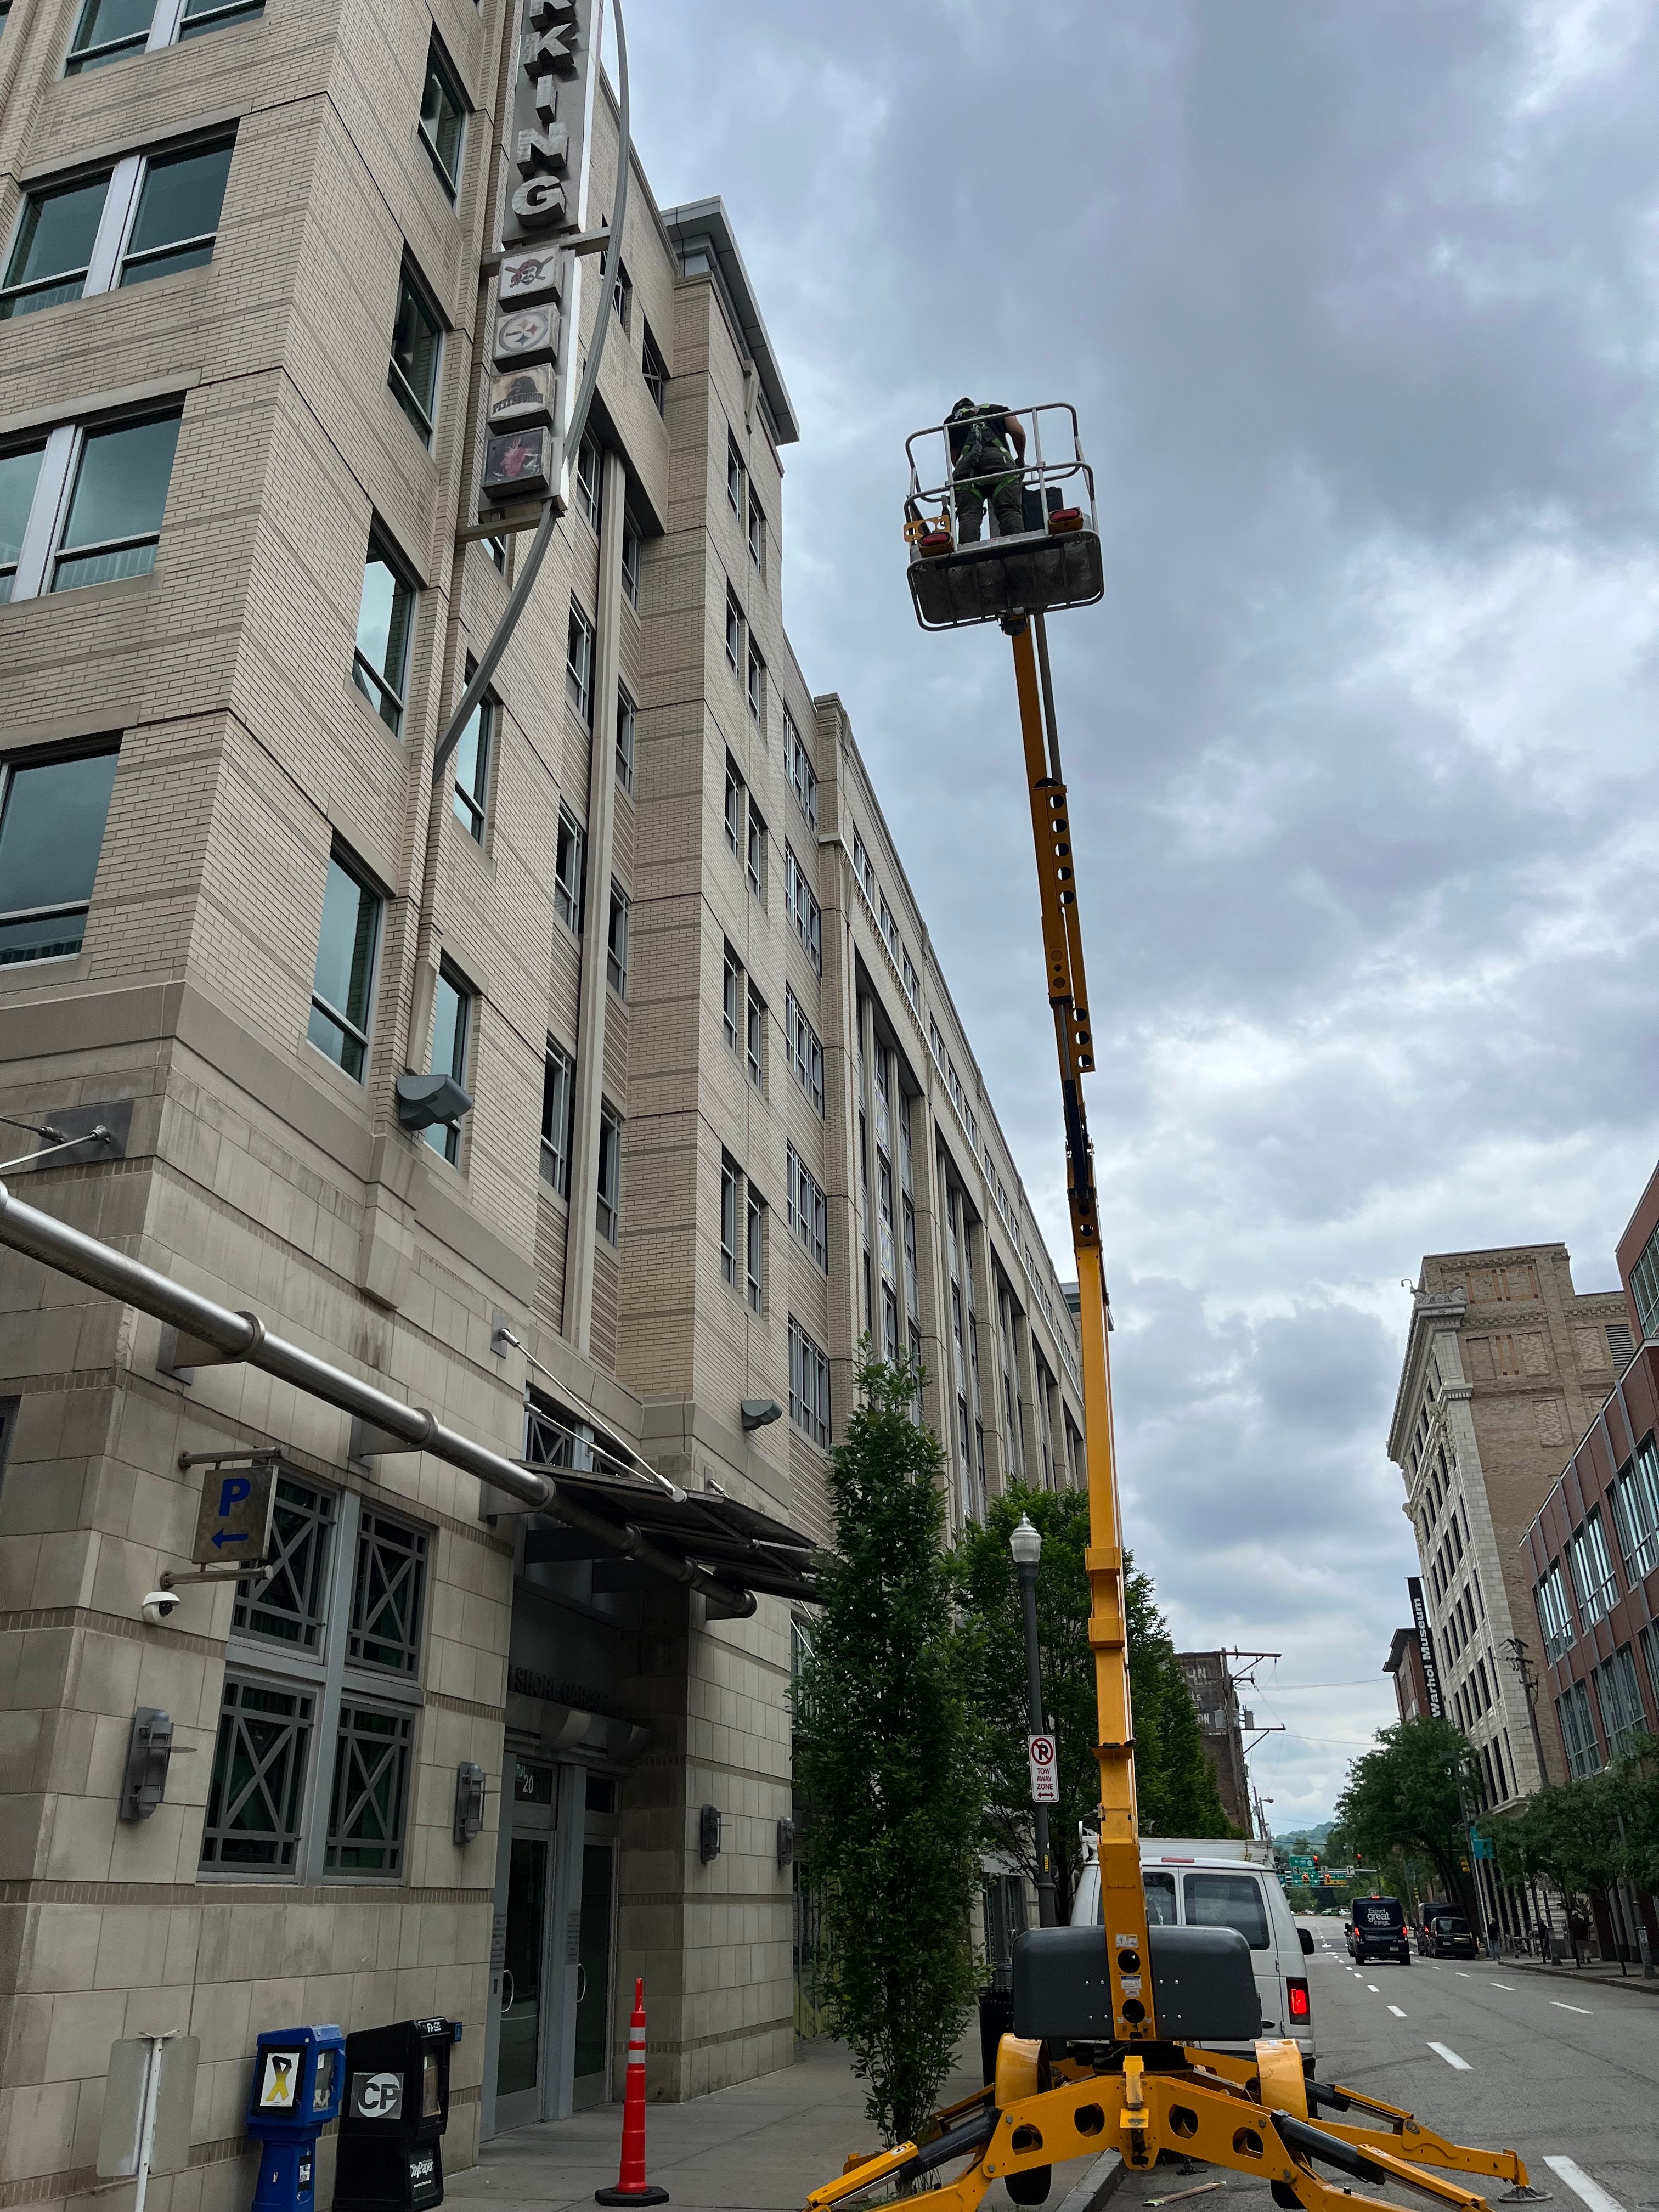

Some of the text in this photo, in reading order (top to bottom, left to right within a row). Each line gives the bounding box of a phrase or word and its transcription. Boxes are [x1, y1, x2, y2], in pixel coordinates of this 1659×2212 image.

[218, 1477, 251, 1517] P
[1414, 1598, 1441, 1718] Warhol Museum
[515, 1667, 559, 1701] SHORE
[523, 1774, 534, 1794] 20
[1367, 1911, 1390, 1922] great
[358, 2081, 399, 2111] CP
